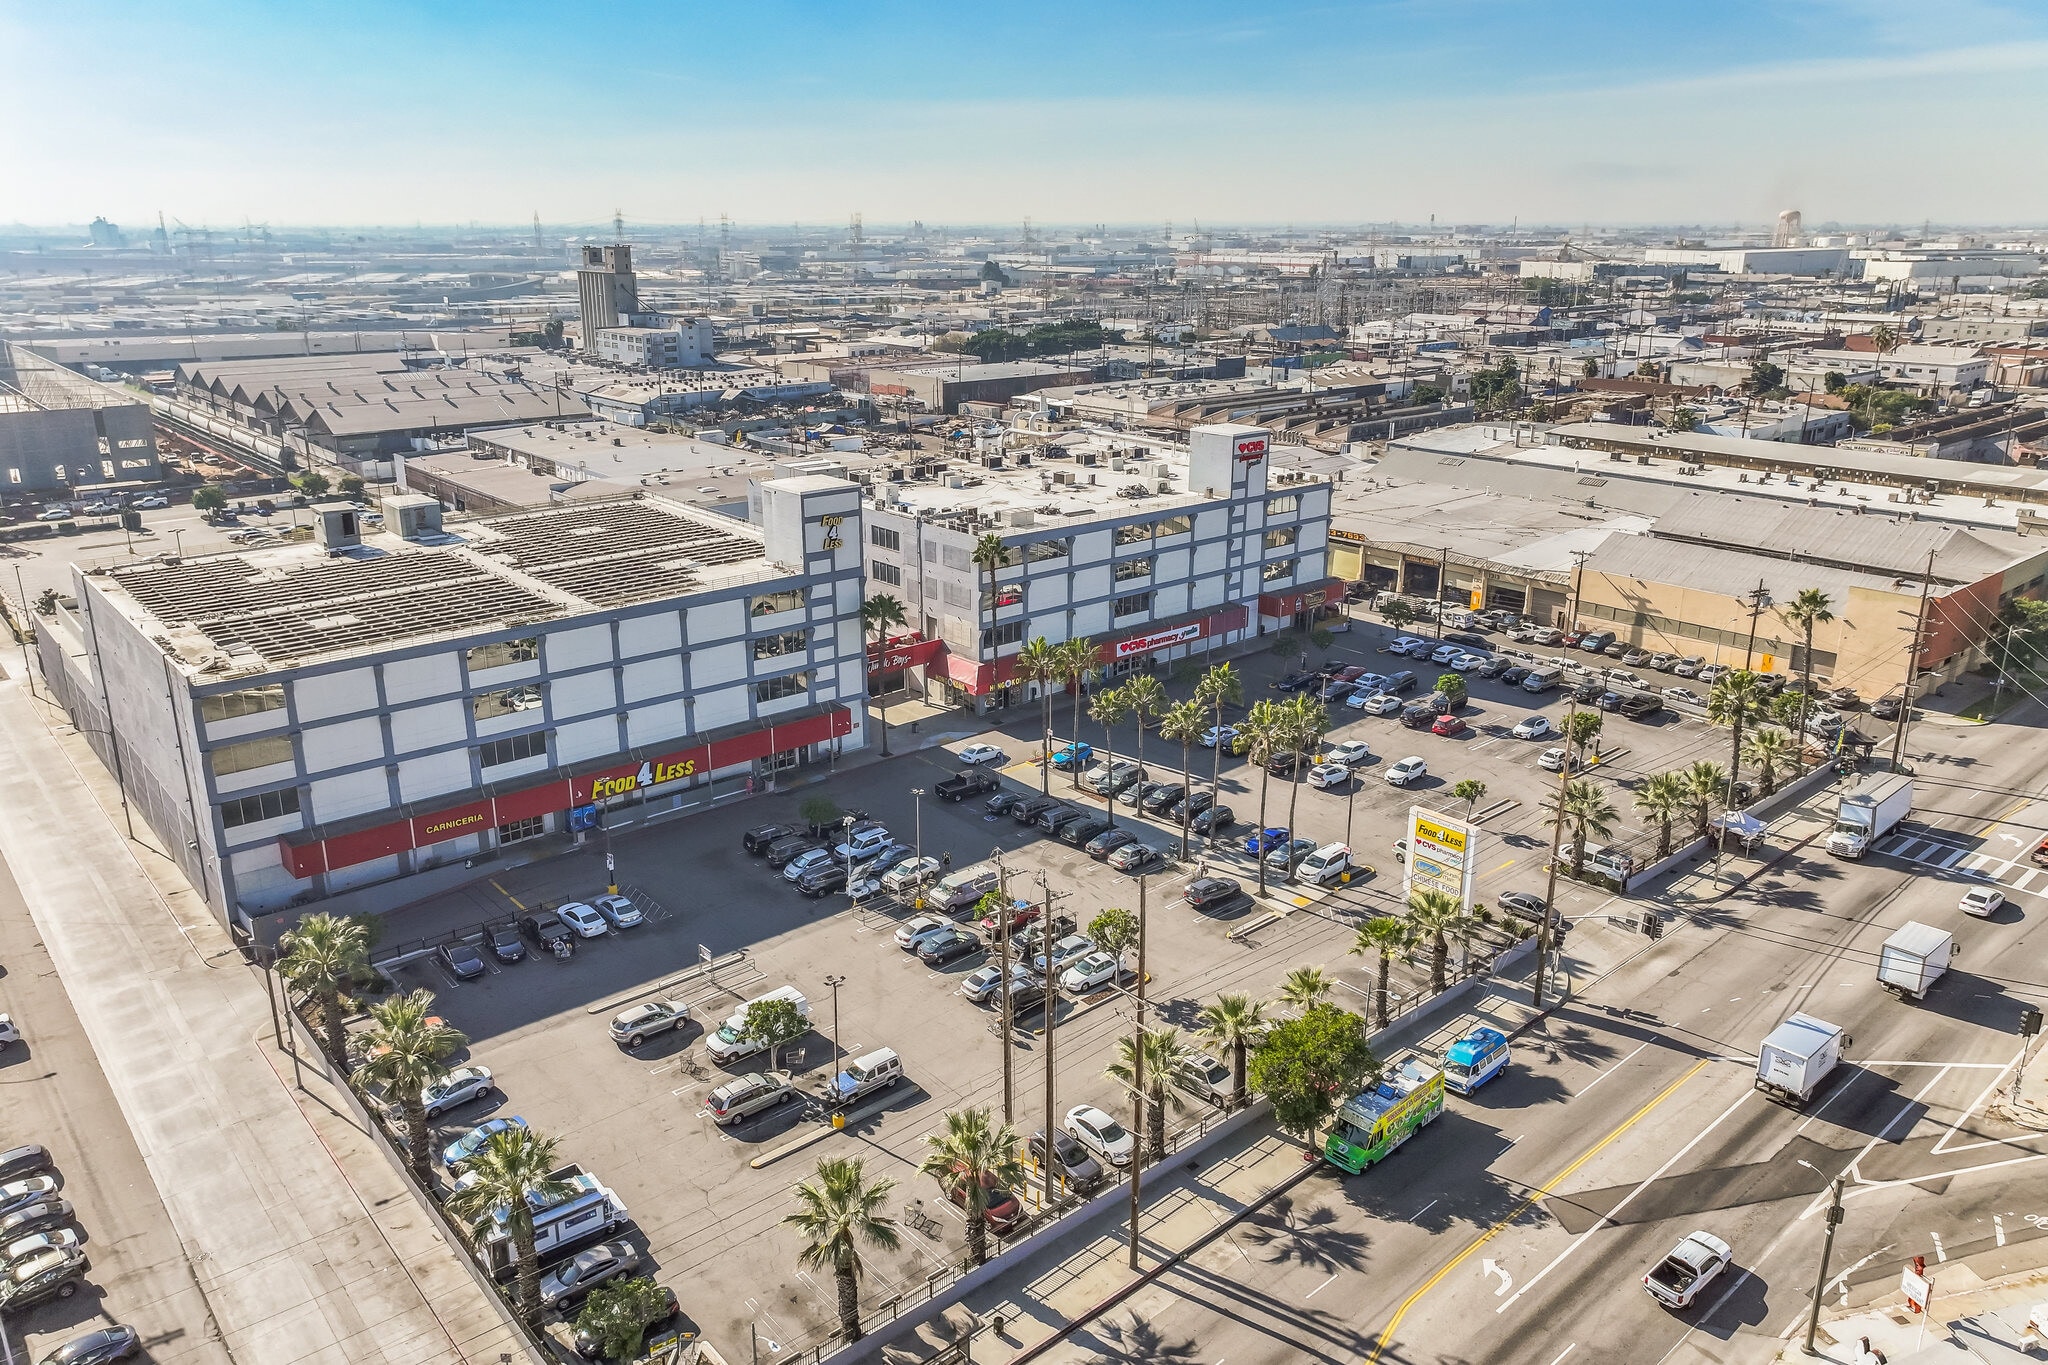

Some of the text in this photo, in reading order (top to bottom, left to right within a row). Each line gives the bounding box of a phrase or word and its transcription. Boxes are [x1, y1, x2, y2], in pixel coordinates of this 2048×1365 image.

[1246, 440, 1264, 452] CVS
[821, 514, 843, 527] FOOD
[828, 525, 838, 540] 4
[823, 538, 843, 550] LESS
[1129, 638, 1147, 651] CVS
[1147, 633, 1179, 648] pharmacy
[989, 682, 1005, 692] HNG
[592, 759, 695, 799] FOOD 4 LESS
[425, 813, 484, 834] CARNICERIA
[1418, 824, 1463, 848] FOOD 4 LESS
[1422, 840, 1463, 862] CVS pharmacy
[1413, 874, 1459, 896] CHINESE FOOD
